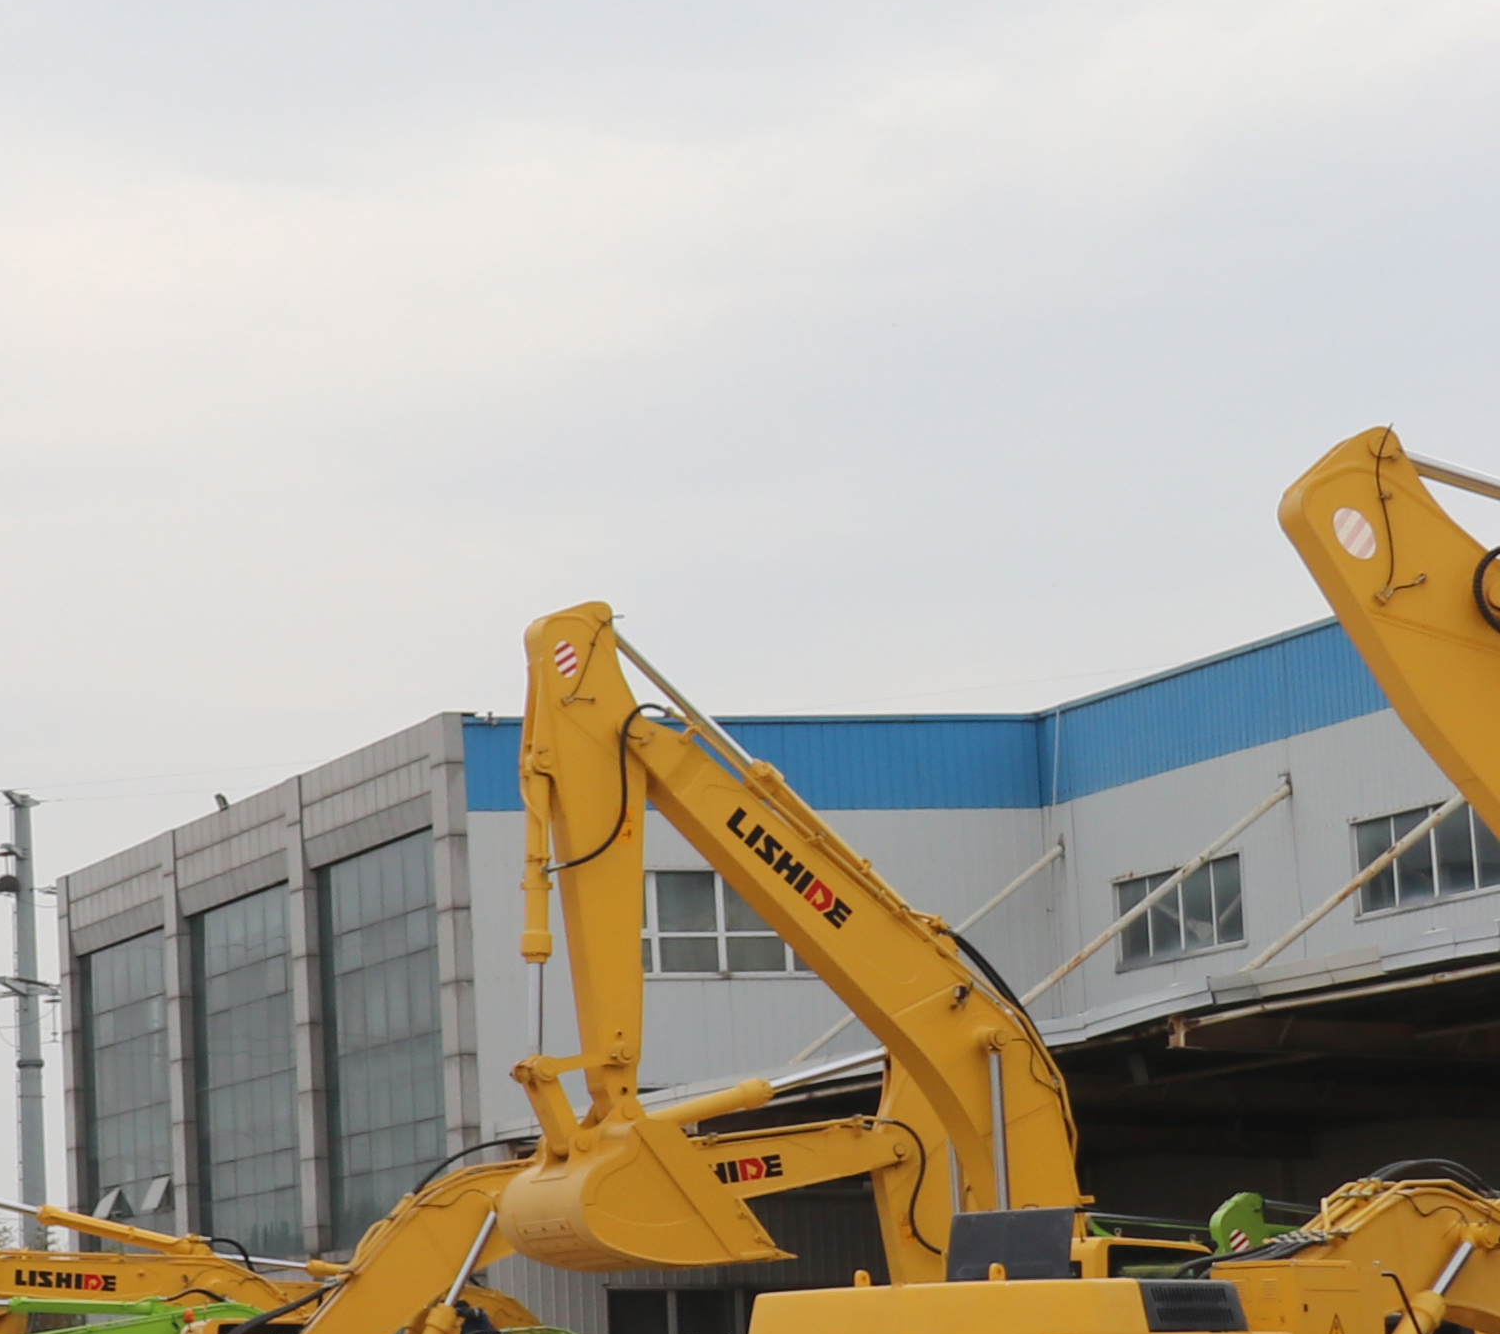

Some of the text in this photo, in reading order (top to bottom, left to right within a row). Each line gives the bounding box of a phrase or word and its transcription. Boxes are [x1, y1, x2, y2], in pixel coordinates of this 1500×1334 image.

[726, 808, 852, 930] LISHIDE
[708, 1154, 783, 1184] HIDE
[14, 1269, 117, 1292] LISHIDE
